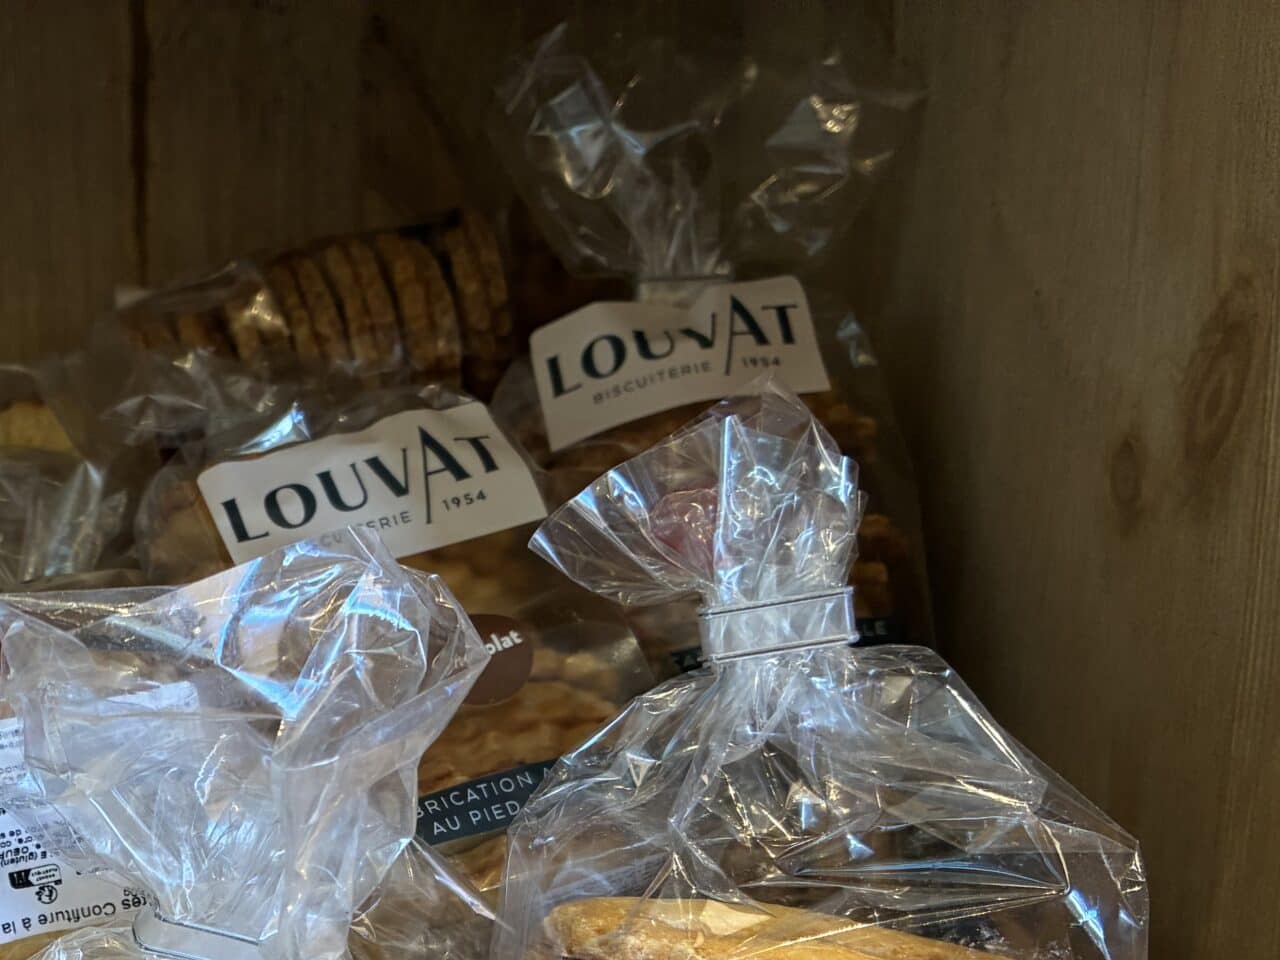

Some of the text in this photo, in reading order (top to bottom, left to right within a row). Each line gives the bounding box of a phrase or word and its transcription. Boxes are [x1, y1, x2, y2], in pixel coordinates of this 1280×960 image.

[546, 294, 798, 398] LOUVAT
[221, 425, 499, 542] LOUVAT
[442, 489, 487, 511] 1954
[484, 630, 522, 655] olat
[433, 800, 521, 836] AU PIED
[21, 917, 32, 931] à
[37, 901, 116, 928] Confiture
[1, 921, 16, 936] la
